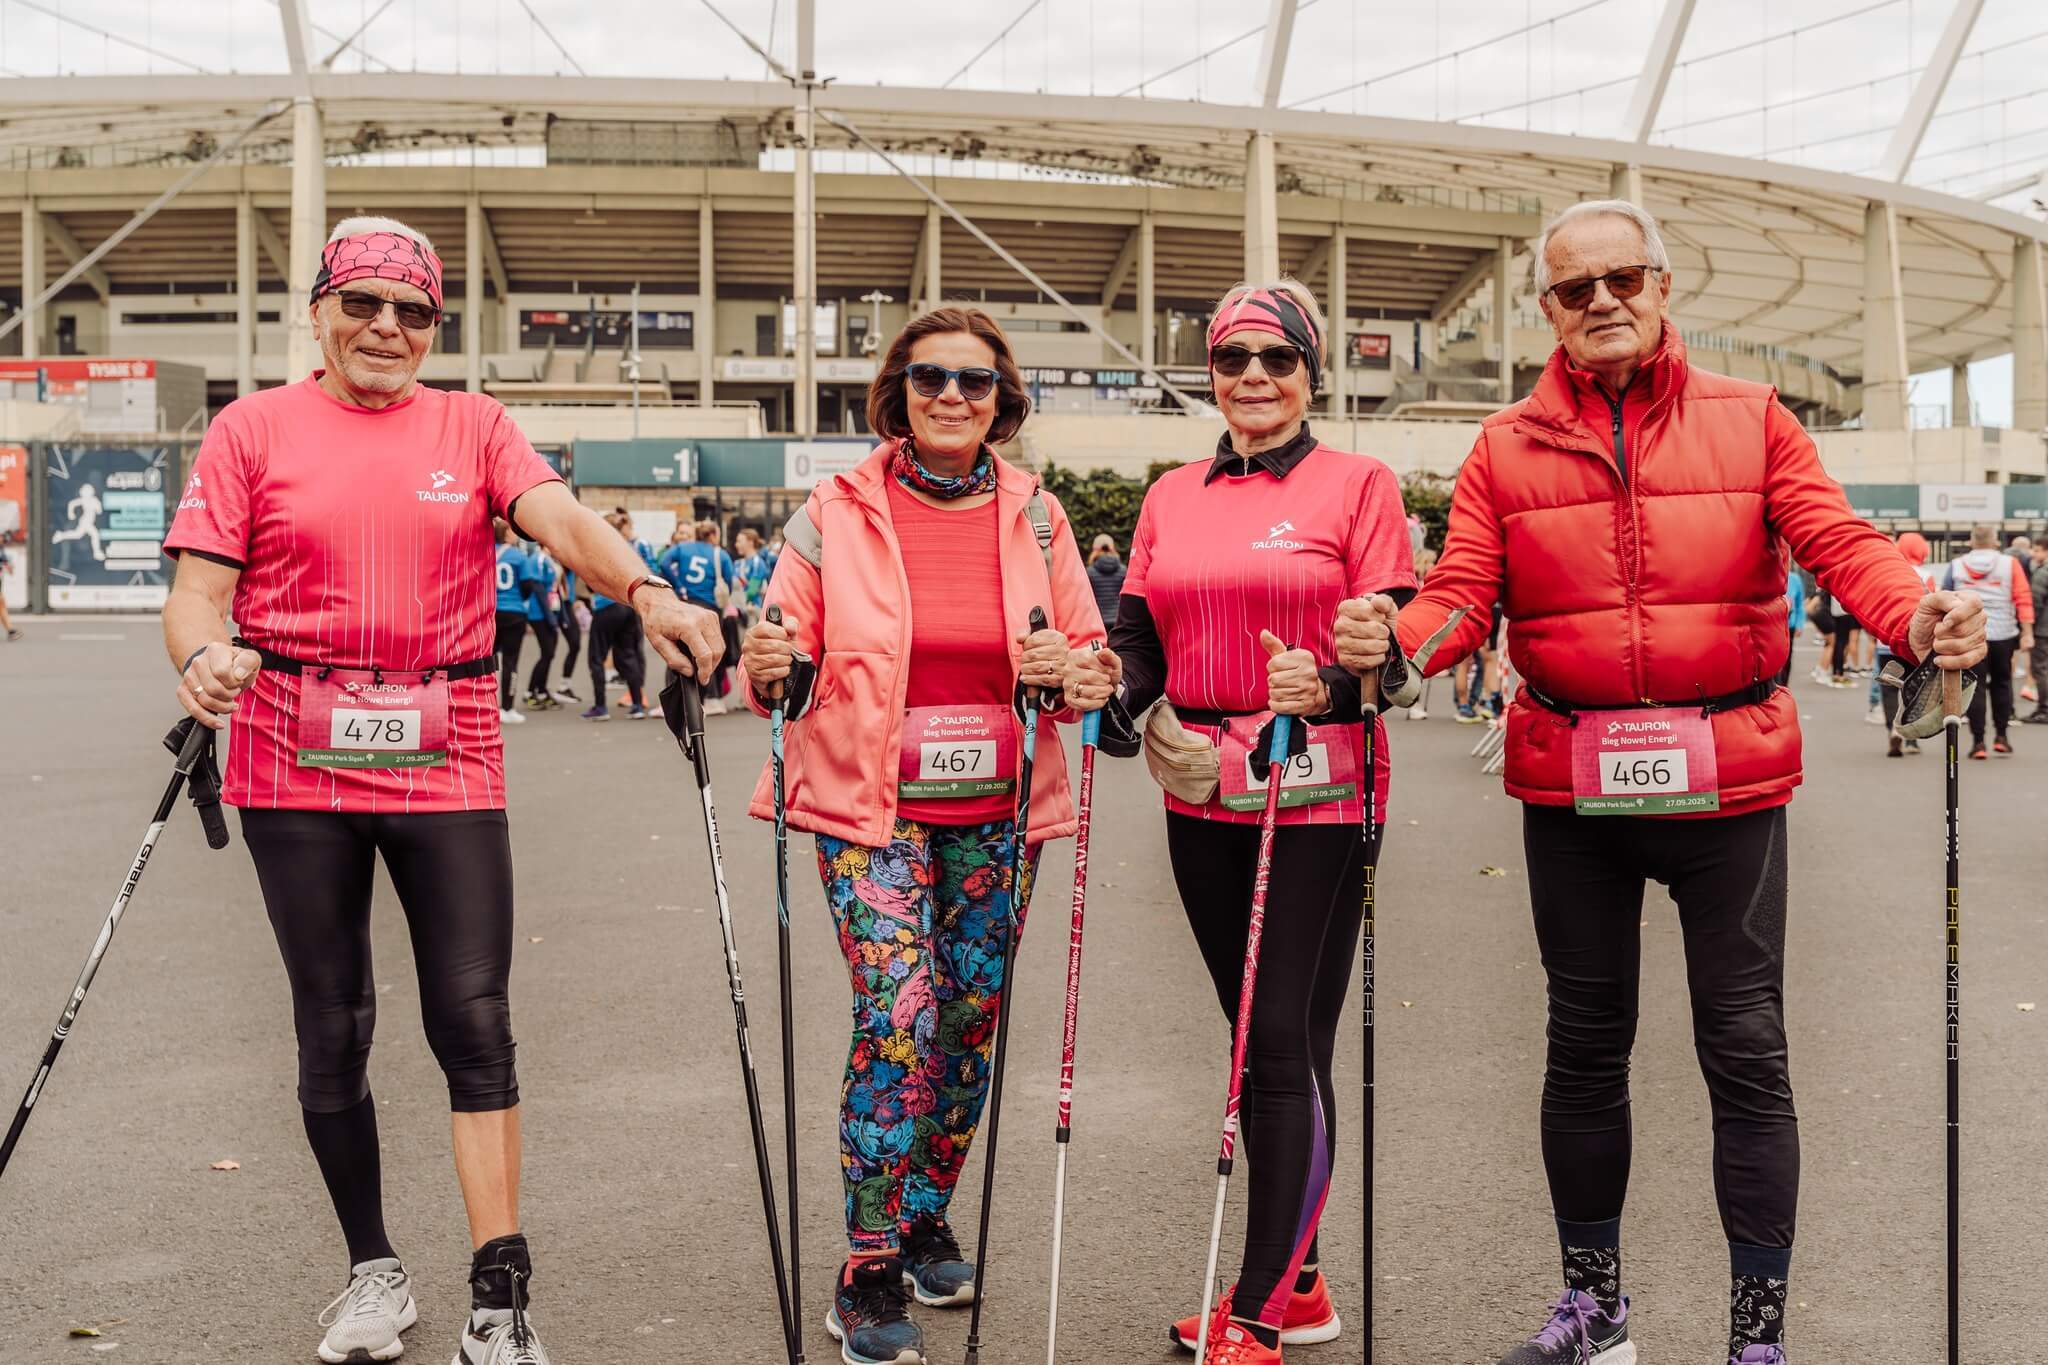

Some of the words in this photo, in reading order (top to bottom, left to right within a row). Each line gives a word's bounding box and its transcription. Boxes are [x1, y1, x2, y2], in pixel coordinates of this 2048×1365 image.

[673, 448, 690, 482] 1
[415, 489, 469, 503] TAURON
[1250, 539, 1304, 550] TAURON
[685, 555, 708, 583] 5
[360, 683, 408, 693] TAURON
[337, 694, 356, 704] Bieg
[357, 696, 383, 705] Nowej
[384, 697, 414, 705] Energii
[942, 716, 984, 725] TAURON
[1622, 721, 1671, 732] TAURON
[344, 718, 404, 743] 478
[923, 729, 940, 738] Bieg
[940, 728, 964, 737] Nowej
[964, 727, 990, 736] Energii
[1601, 737, 1619, 747] Bieg
[1620, 735, 1647, 746] Nowej
[1648, 734, 1678, 745] Energii
[308, 753, 334, 761] TAURON
[932, 749, 982, 772] 467
[1613, 759, 1671, 786] 466
[1309, 788, 1346, 799] 27.09.2025
[1665, 798, 1706, 807] 27.09.2025
[119, 843, 153, 903] GABEL
[1362, 865, 1375, 1027] PACEMAKER
[1946, 887, 1959, 1061] PACEMAKER
